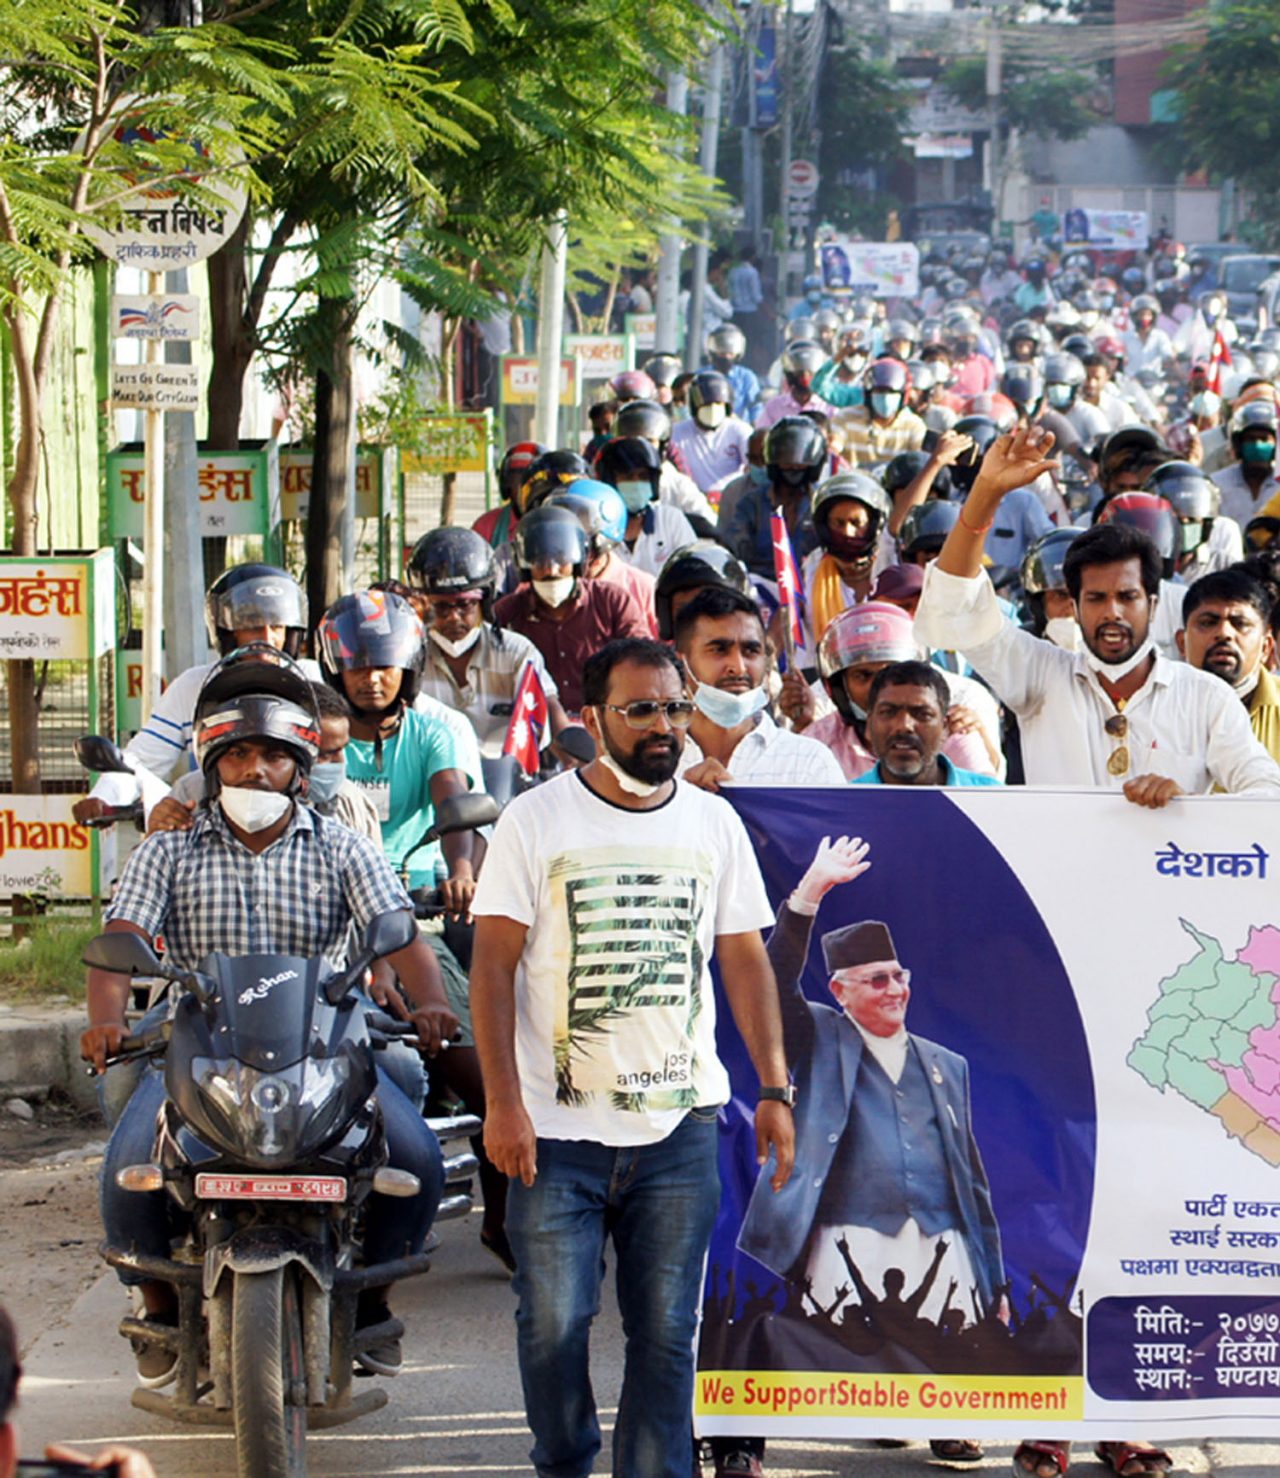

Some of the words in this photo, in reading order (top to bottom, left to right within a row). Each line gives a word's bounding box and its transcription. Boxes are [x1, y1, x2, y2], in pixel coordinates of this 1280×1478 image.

[160, 240, 198, 262] प्रहरी
[1155, 842, 1269, 879] देशको
[2, 873, 39, 888] lower
[664, 1051, 688, 1068] los
[616, 1067, 688, 1088] angeles
[1185, 1194, 1227, 1217] पार्टी
[1169, 1224, 1221, 1248] स्थाई
[1120, 1258, 1179, 1277] पक्षमा
[701, 1378, 734, 1405] We
[918, 1382, 1067, 1411] Government
